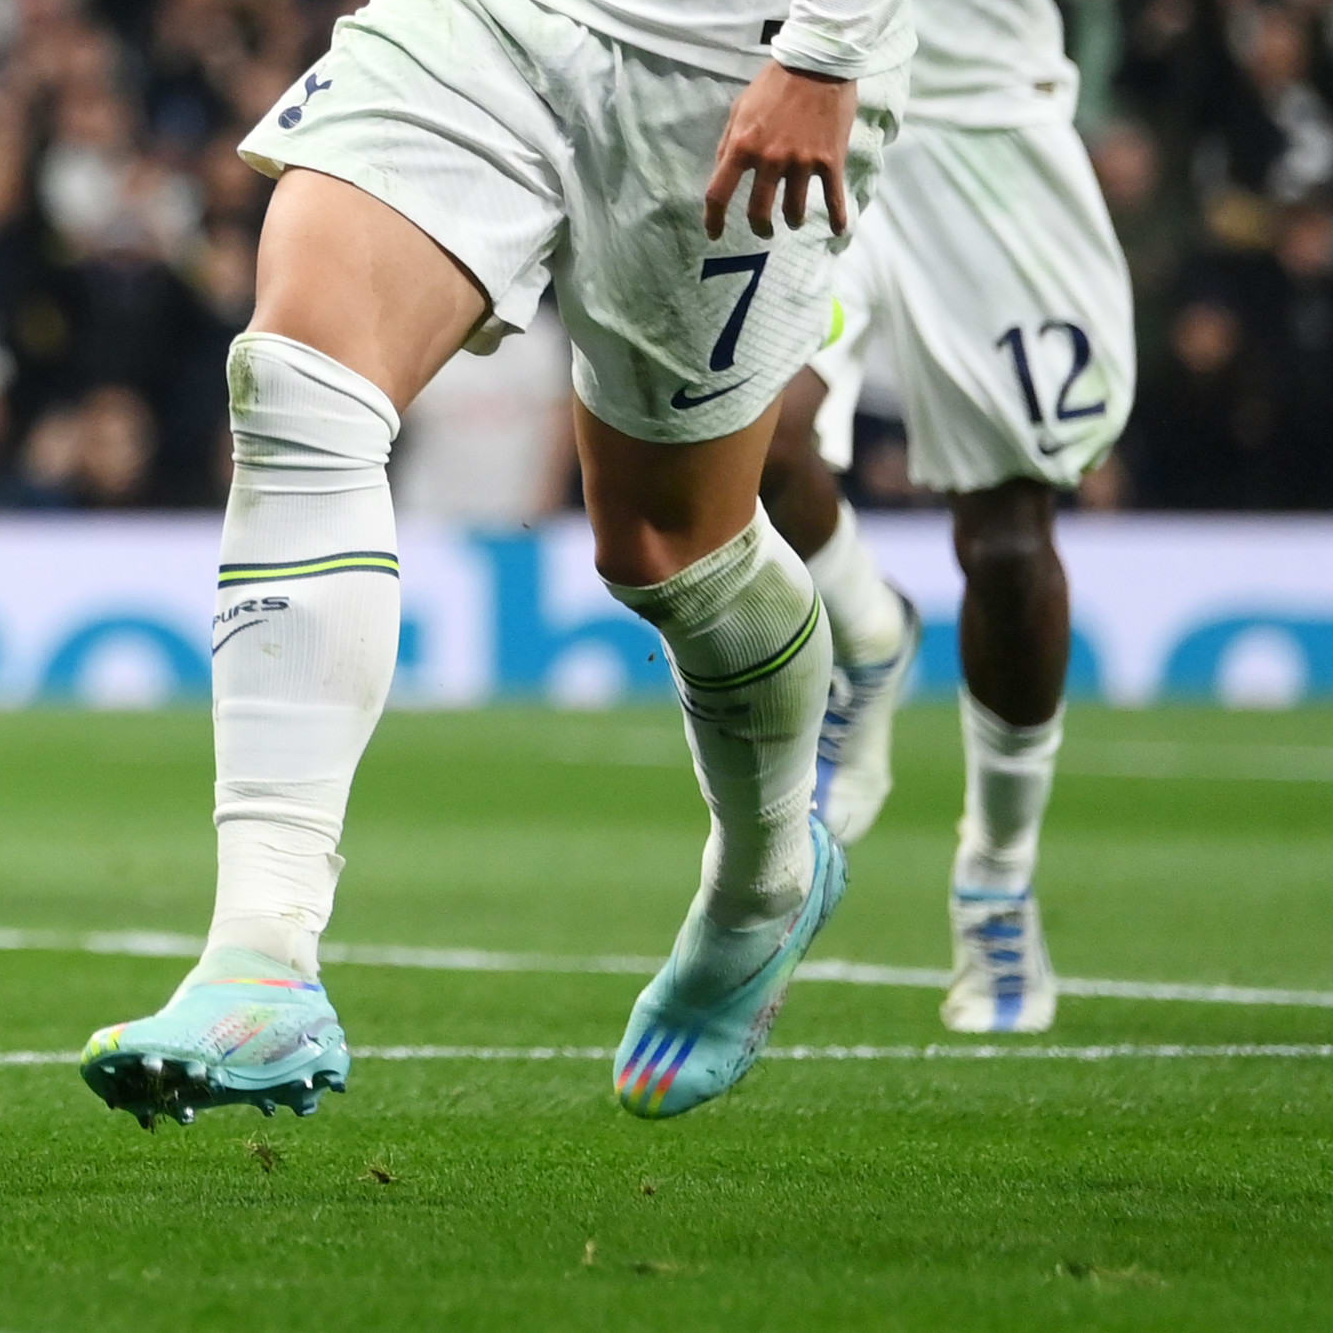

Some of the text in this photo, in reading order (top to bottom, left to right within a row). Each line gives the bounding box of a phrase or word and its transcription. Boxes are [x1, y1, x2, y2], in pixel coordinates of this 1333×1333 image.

[700, 251, 770, 372] 7
[995, 319, 1107, 425] 12
[212, 596, 290, 630] PURS
